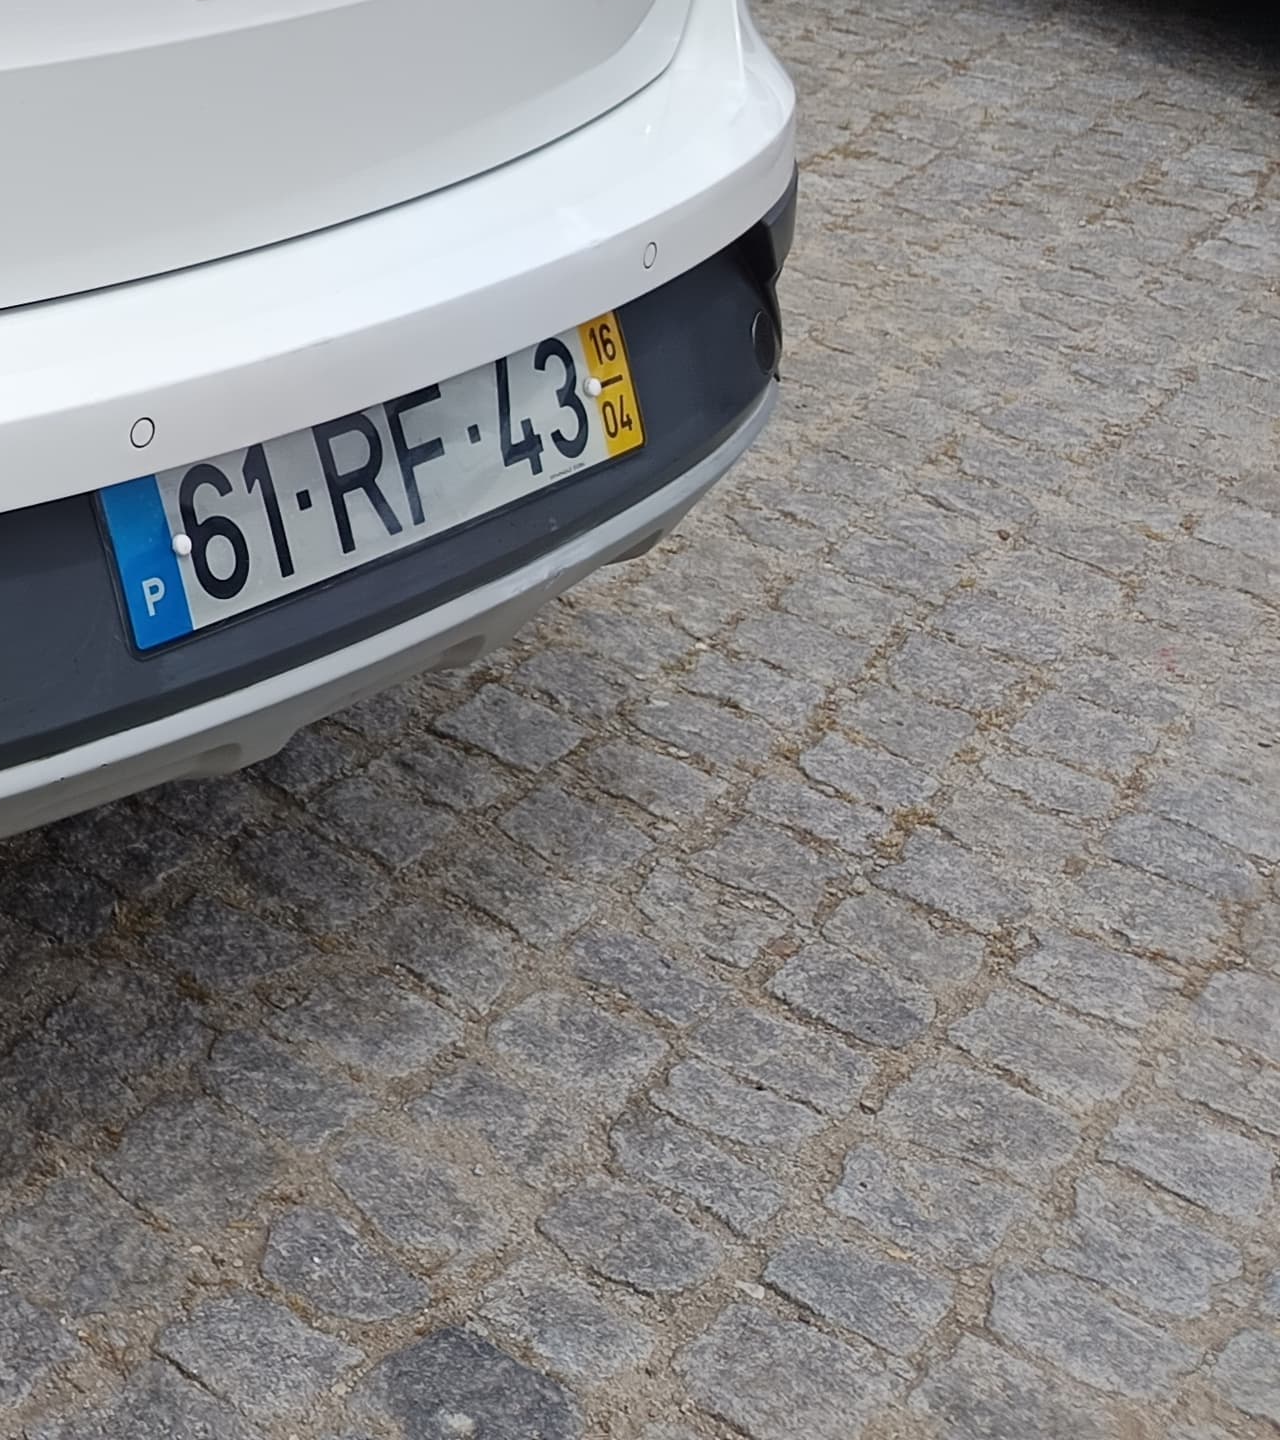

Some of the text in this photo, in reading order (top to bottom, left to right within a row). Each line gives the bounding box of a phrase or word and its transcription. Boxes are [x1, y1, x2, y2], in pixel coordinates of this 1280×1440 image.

[588, 323, 617, 365] 16
[602, 396, 633, 439] 04
[141, 577, 166, 617] P
